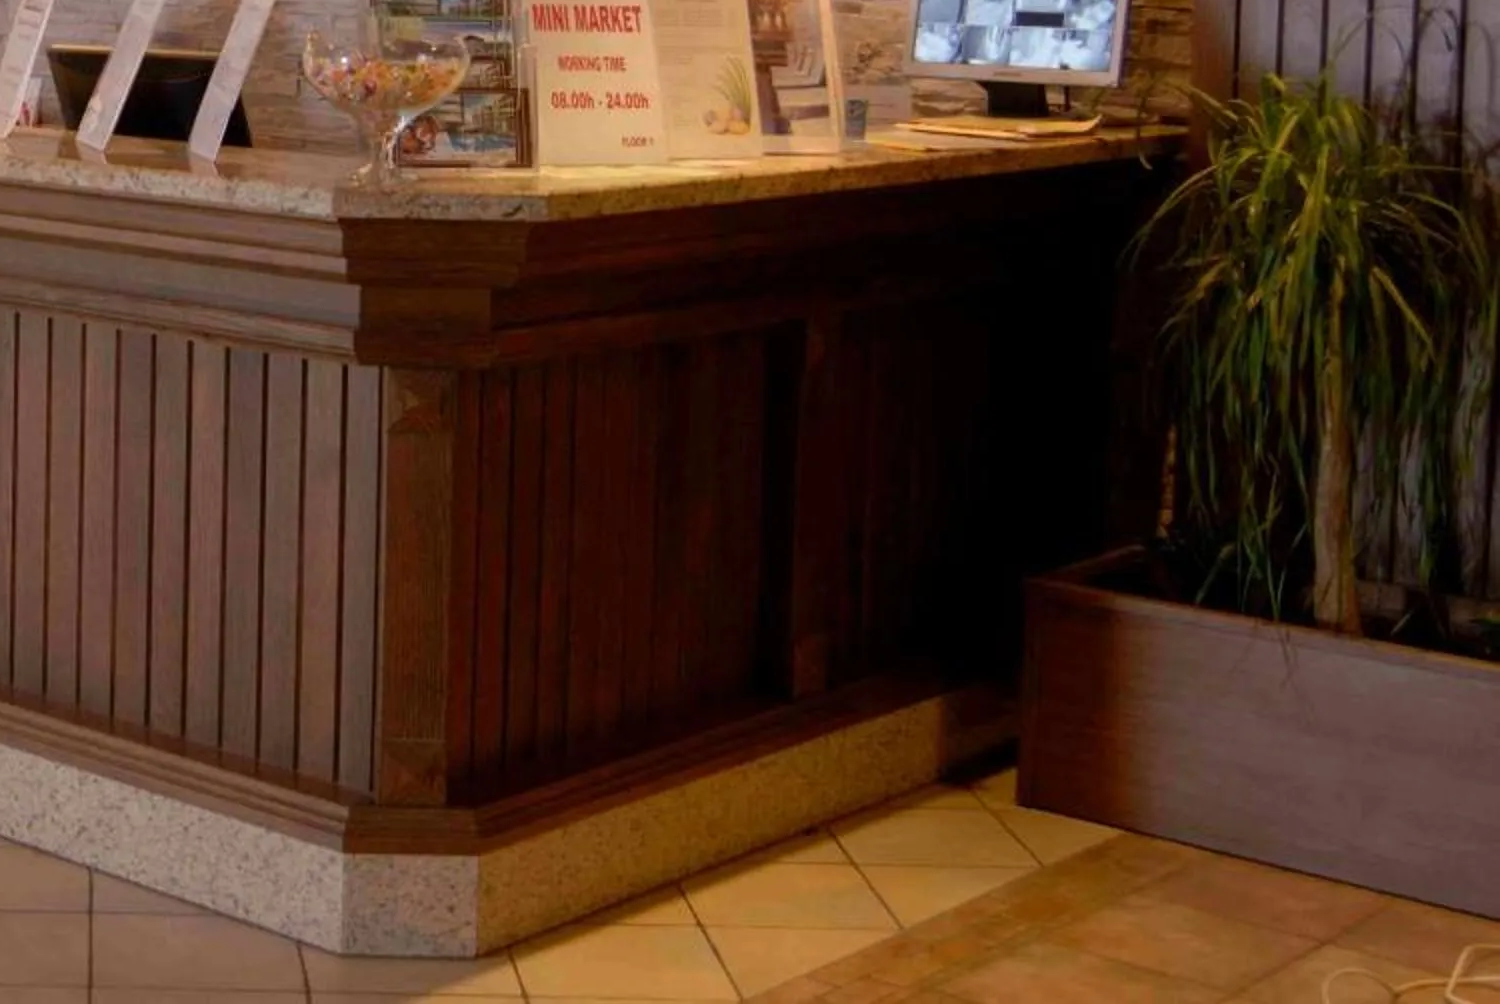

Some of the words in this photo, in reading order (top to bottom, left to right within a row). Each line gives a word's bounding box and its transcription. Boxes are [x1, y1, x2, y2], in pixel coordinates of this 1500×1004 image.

[532, 3, 570, 32] MINI
[573, 4, 642, 33] MARKET
[558, 56, 601, 72] WORKING
[603, 56, 627, 72] TIME
[551, 91, 595, 109] 08.00h
[605, 92, 649, 109] 24.00h
